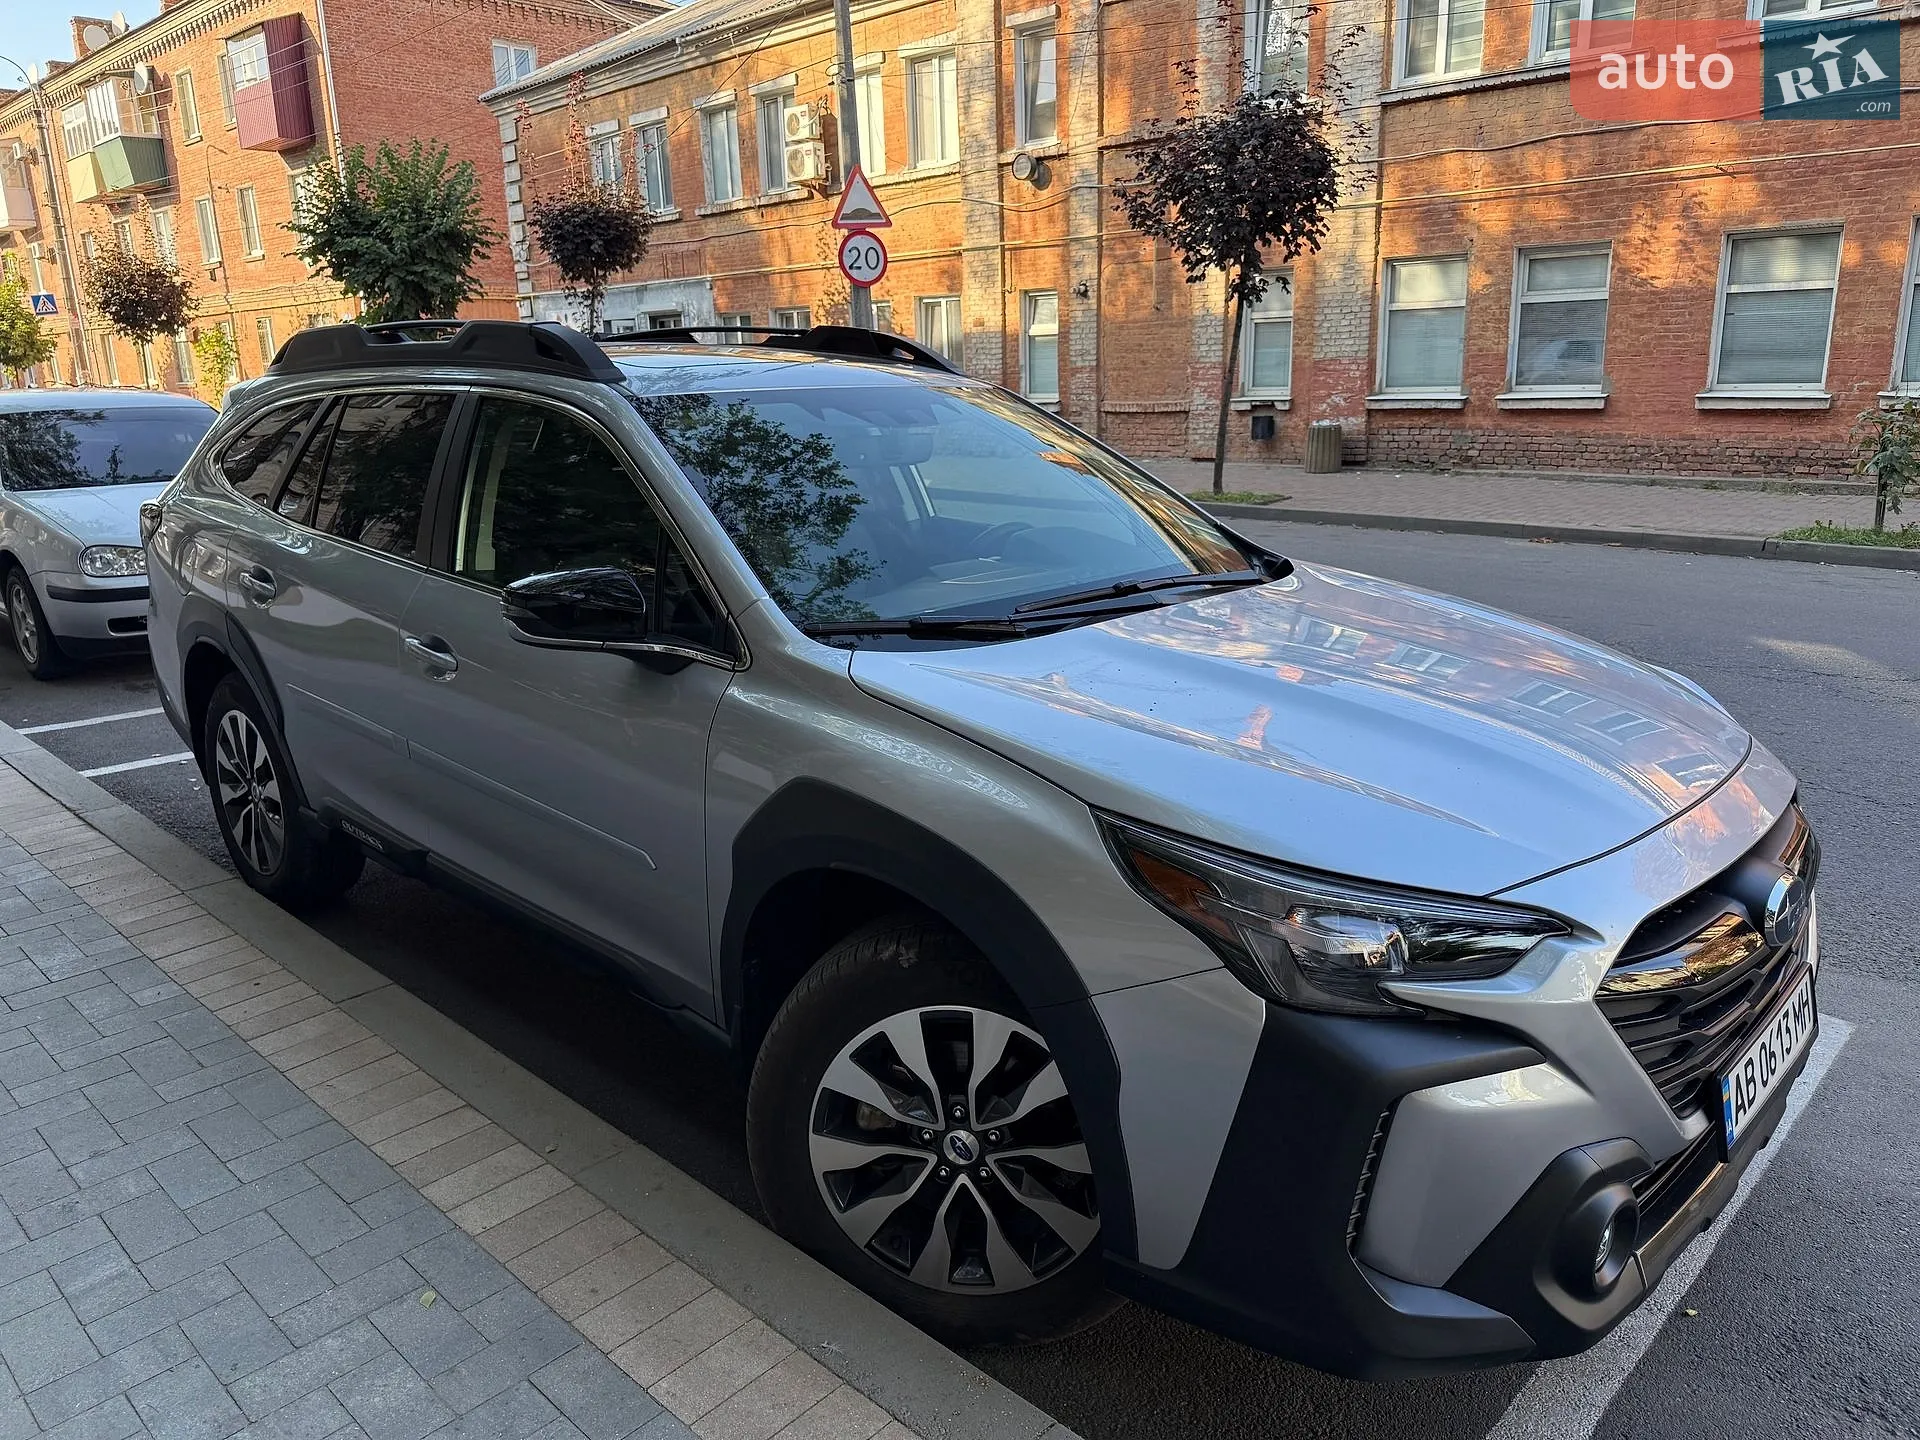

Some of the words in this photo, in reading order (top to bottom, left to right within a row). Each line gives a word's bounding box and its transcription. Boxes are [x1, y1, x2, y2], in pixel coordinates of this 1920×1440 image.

[848, 246, 880, 270] 20
[1733, 1056, 1757, 1128] AB
[1758, 1008, 1792, 1089] 0613
[1792, 981, 1812, 1044] MH
